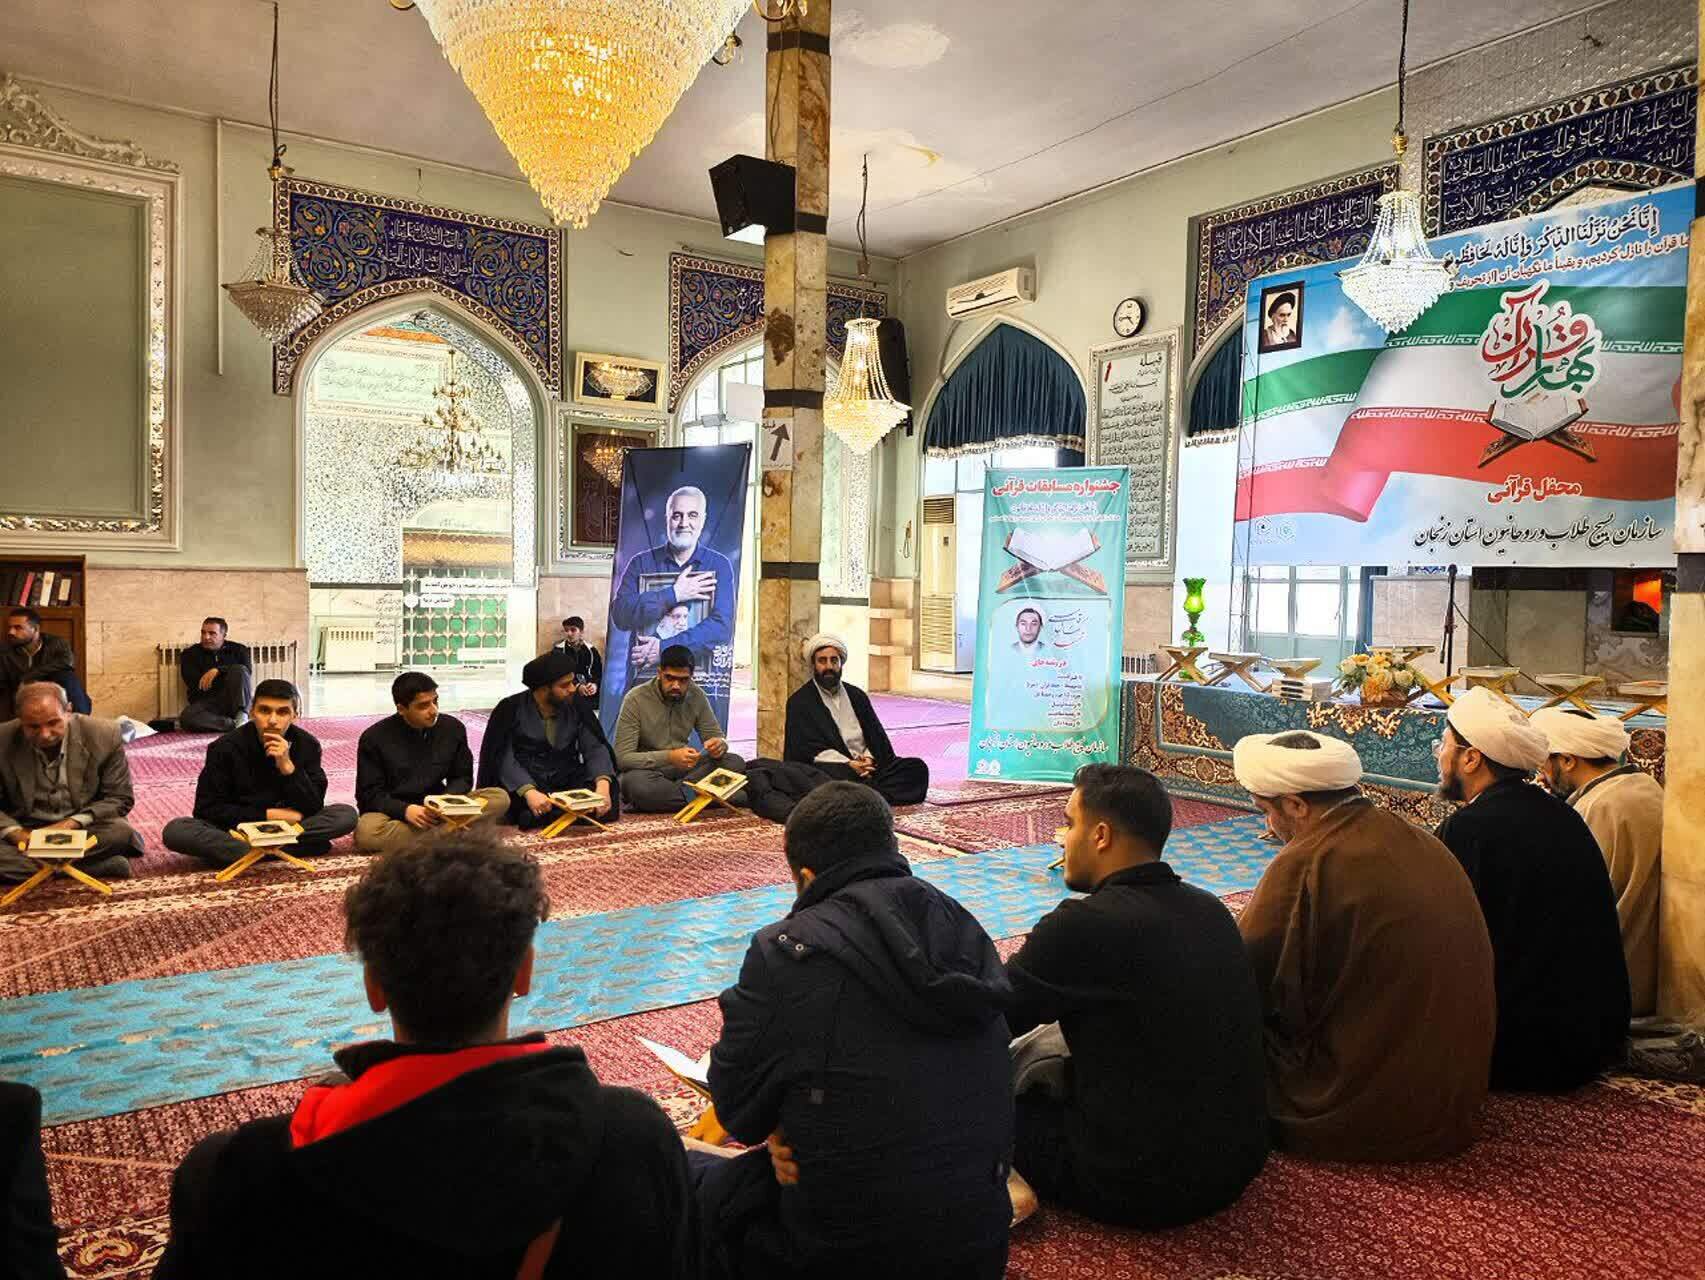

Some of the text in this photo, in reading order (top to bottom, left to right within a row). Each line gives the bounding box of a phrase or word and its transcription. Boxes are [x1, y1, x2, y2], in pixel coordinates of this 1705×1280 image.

[1619, 244, 1642, 260] نازل
[992, 477, 1120, 498] جشنواره مسابقات قرآنی
[1487, 475, 1582, 504] محفل قرآنی
[1414, 515, 1450, 553] زنجان
[1448, 518, 1482, 547] استان
[1481, 514, 1539, 554] روحانیون
[1545, 519, 1590, 549] طلاب
[1588, 512, 1614, 549] بسیج
[1612, 517, 1664, 546] سازمان
